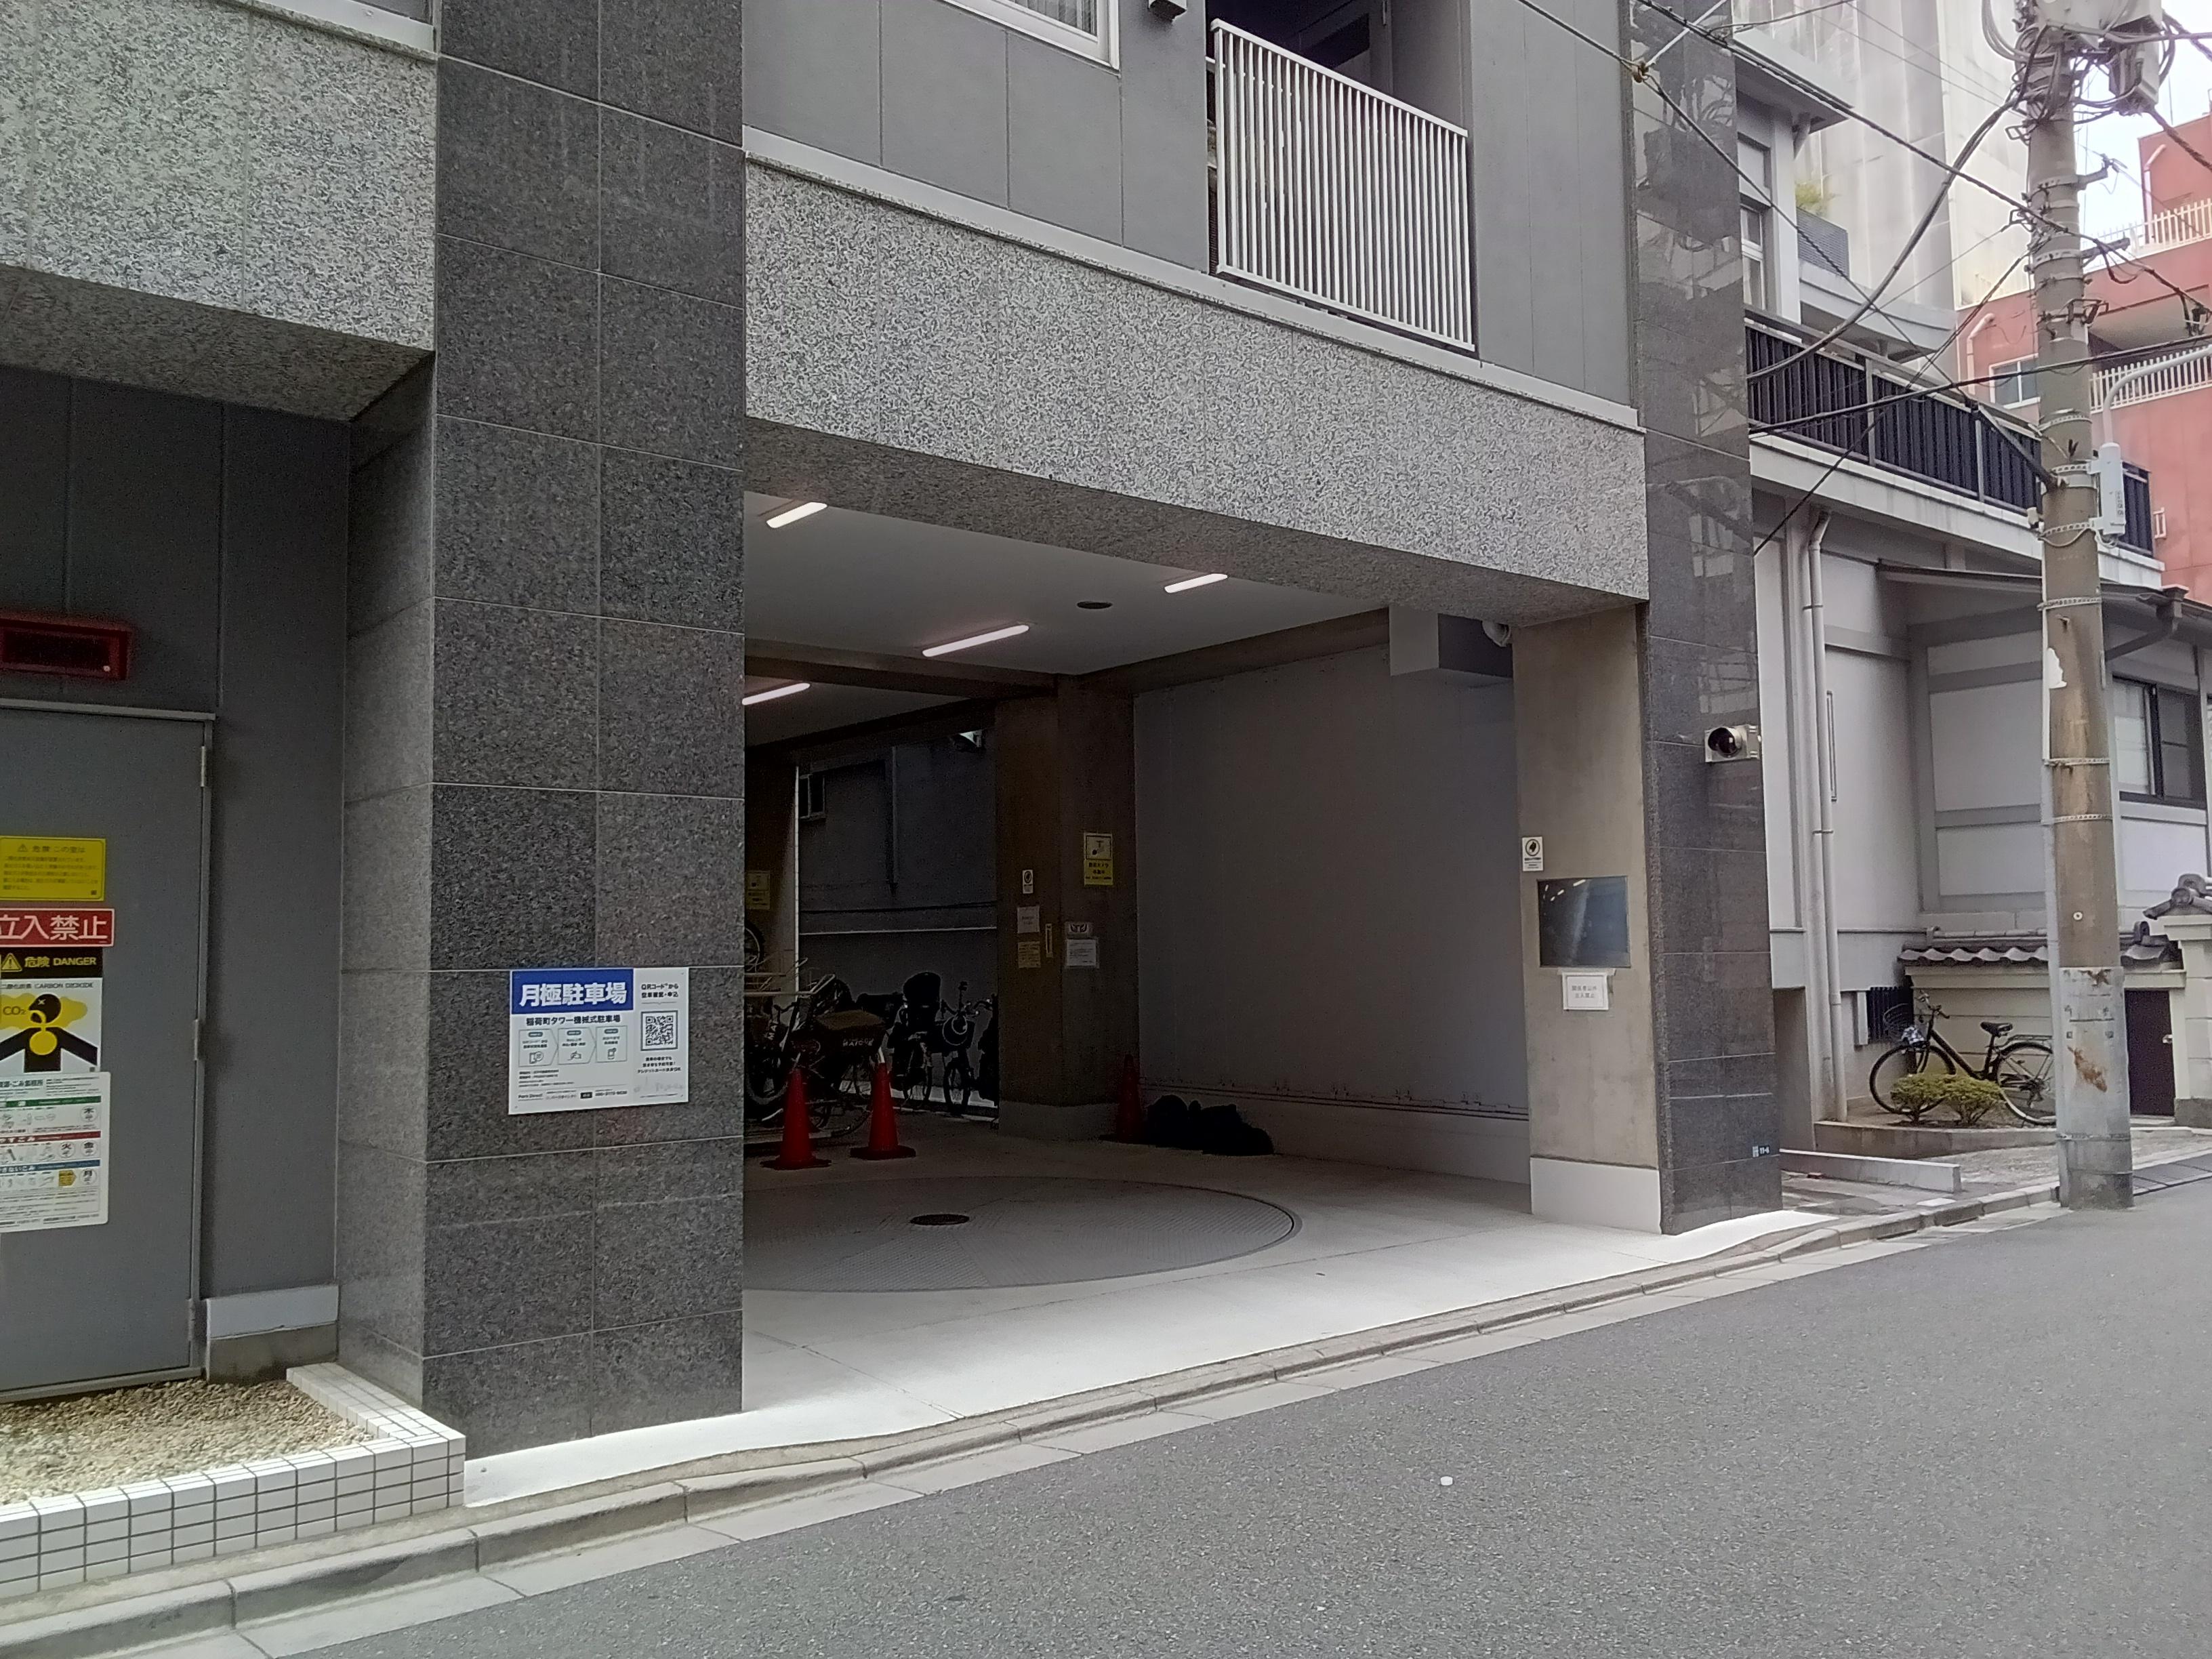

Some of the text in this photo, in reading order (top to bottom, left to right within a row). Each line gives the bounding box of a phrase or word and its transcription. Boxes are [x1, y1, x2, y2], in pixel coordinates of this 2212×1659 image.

[0, 914, 108, 941] 立入禁止
[24, 956, 96, 968] 危険 DANGER
[520, 982, 627, 1006] 月極駐車場
[526, 1015, 620, 1026] 稲荷町タワー機械式駐車場
